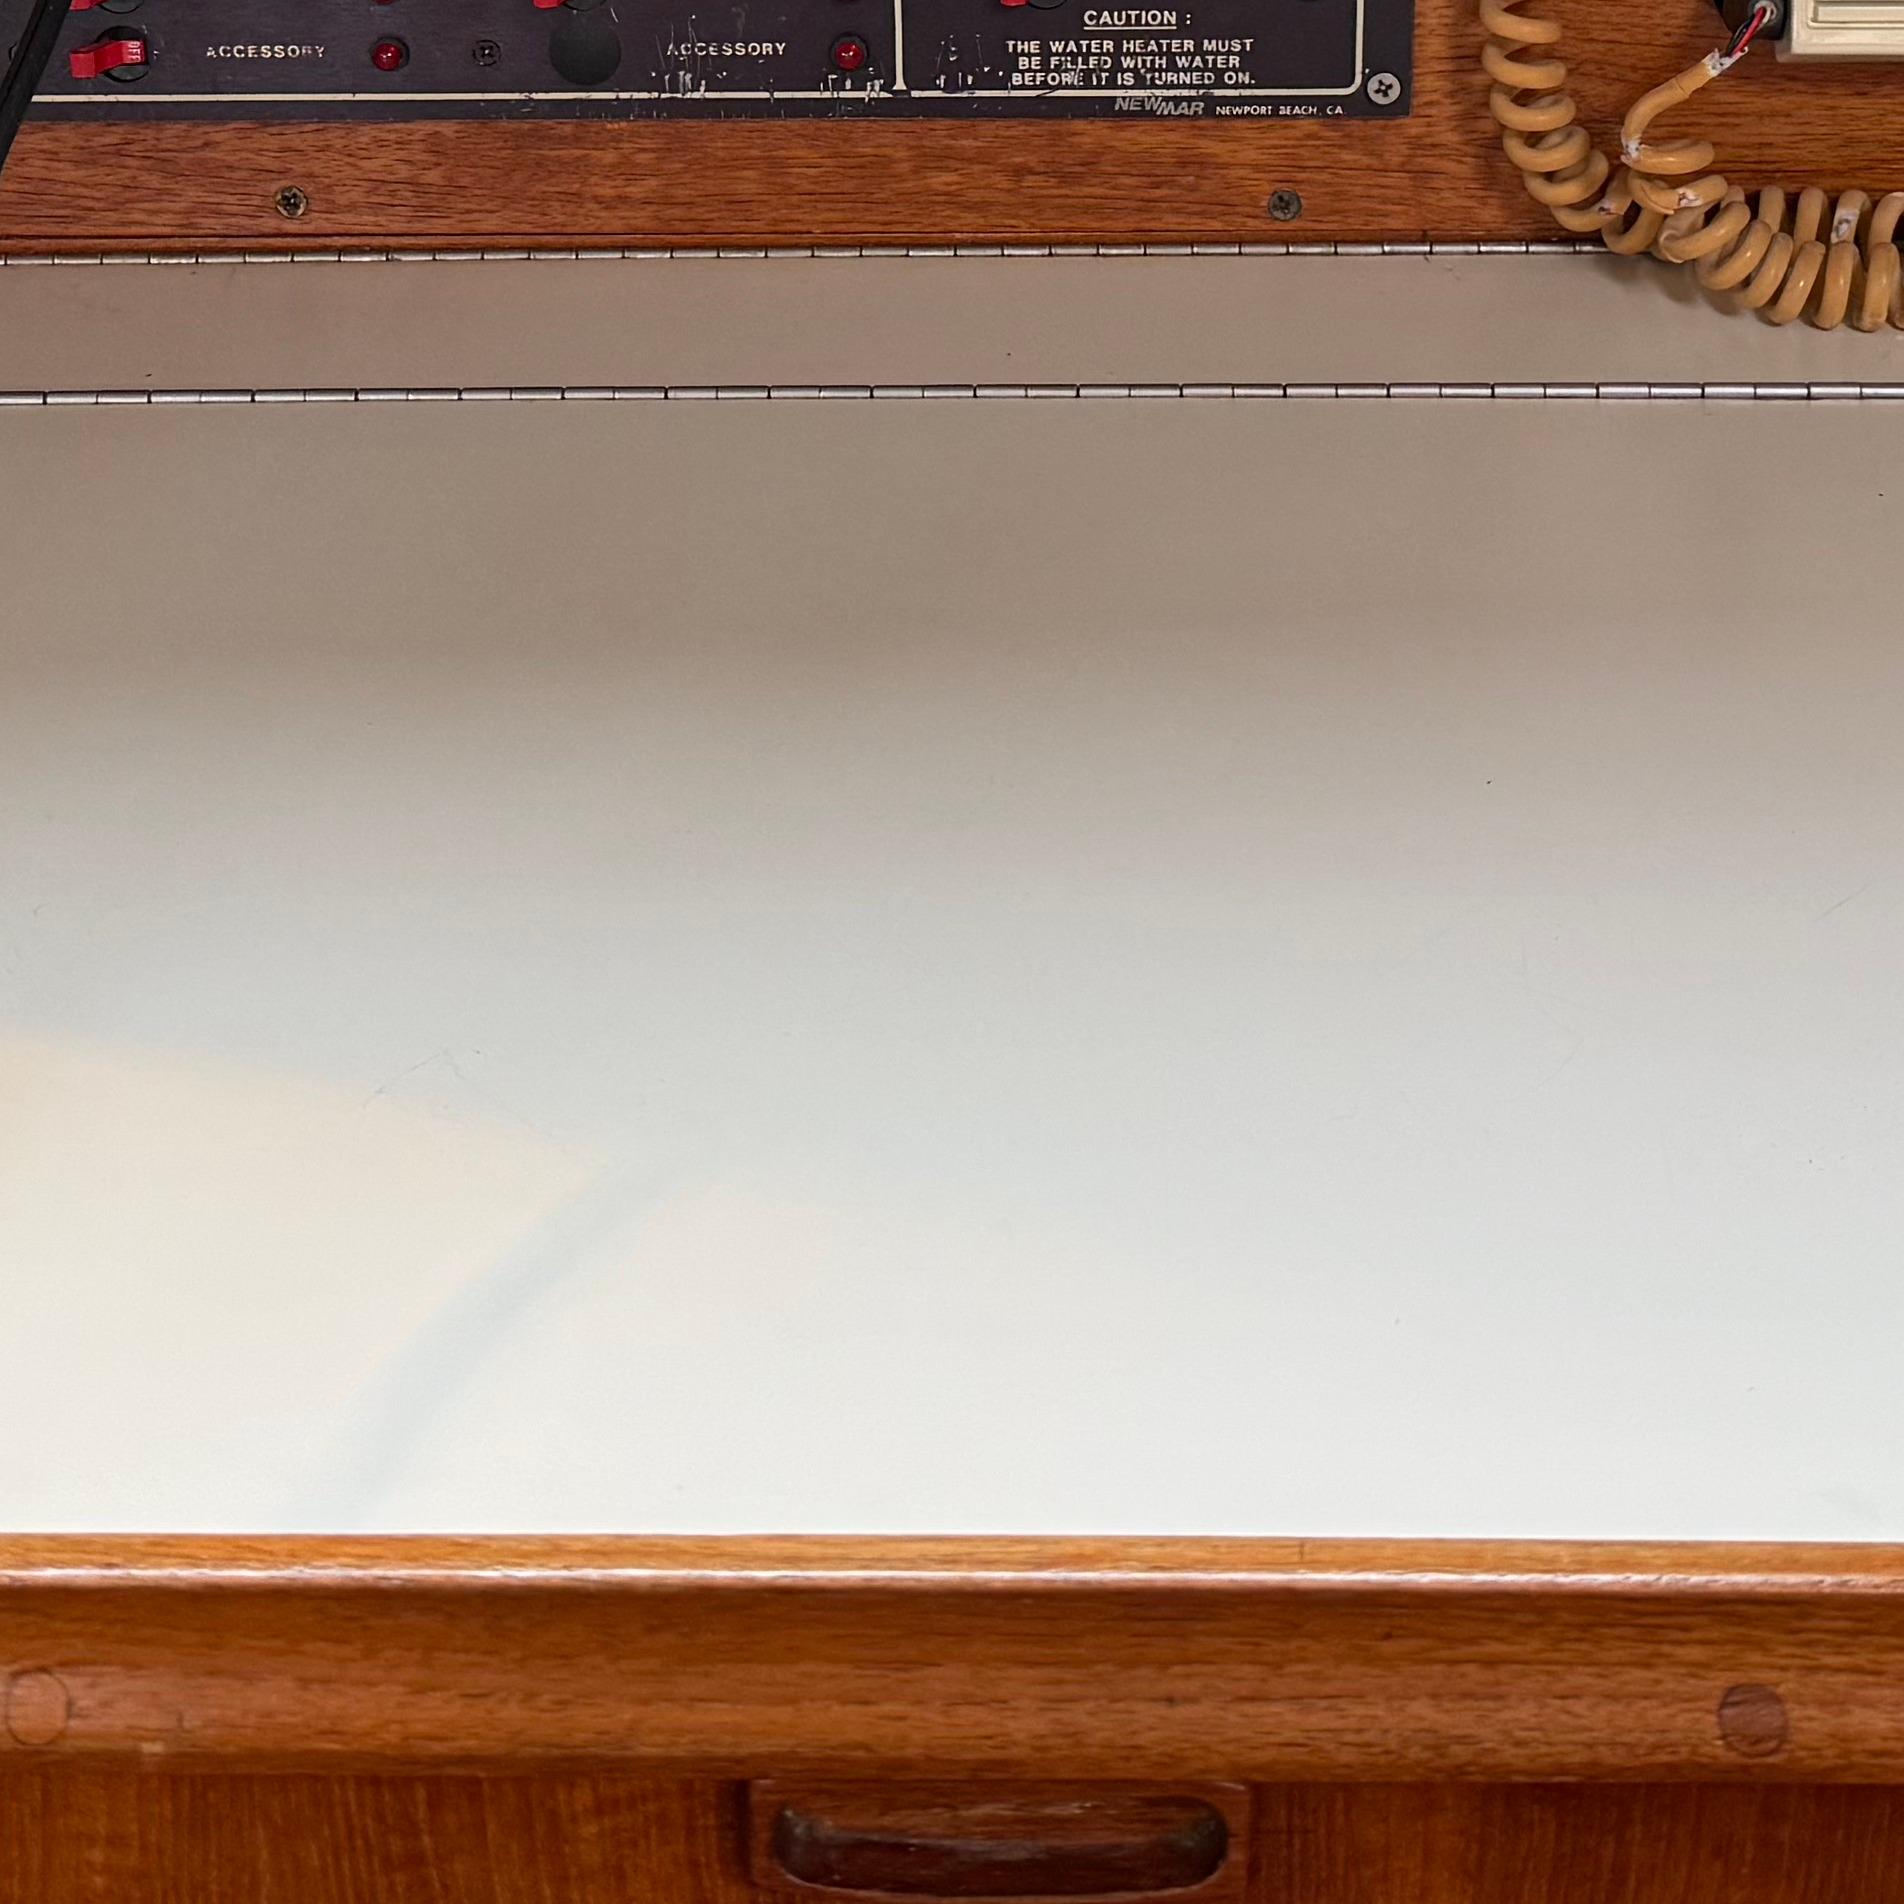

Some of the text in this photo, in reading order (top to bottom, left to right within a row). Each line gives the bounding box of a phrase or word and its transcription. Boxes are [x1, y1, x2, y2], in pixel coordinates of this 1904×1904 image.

[1084, 10, 1176, 25] CAUTION
[128, 41, 141, 62] OFF
[207, 46, 324, 58] ACCESSORY
[667, 43, 785, 55] ACCESSORY
[1006, 39, 1253, 53] THE WATER HEATER MUST
[1019, 55, 1239, 70] BE FILLED WITH WATER
[1012, 71, 1256, 87] BEFORE IT IS TURNED ON.
[1215, 105, 1272, 116] NEWPORT
